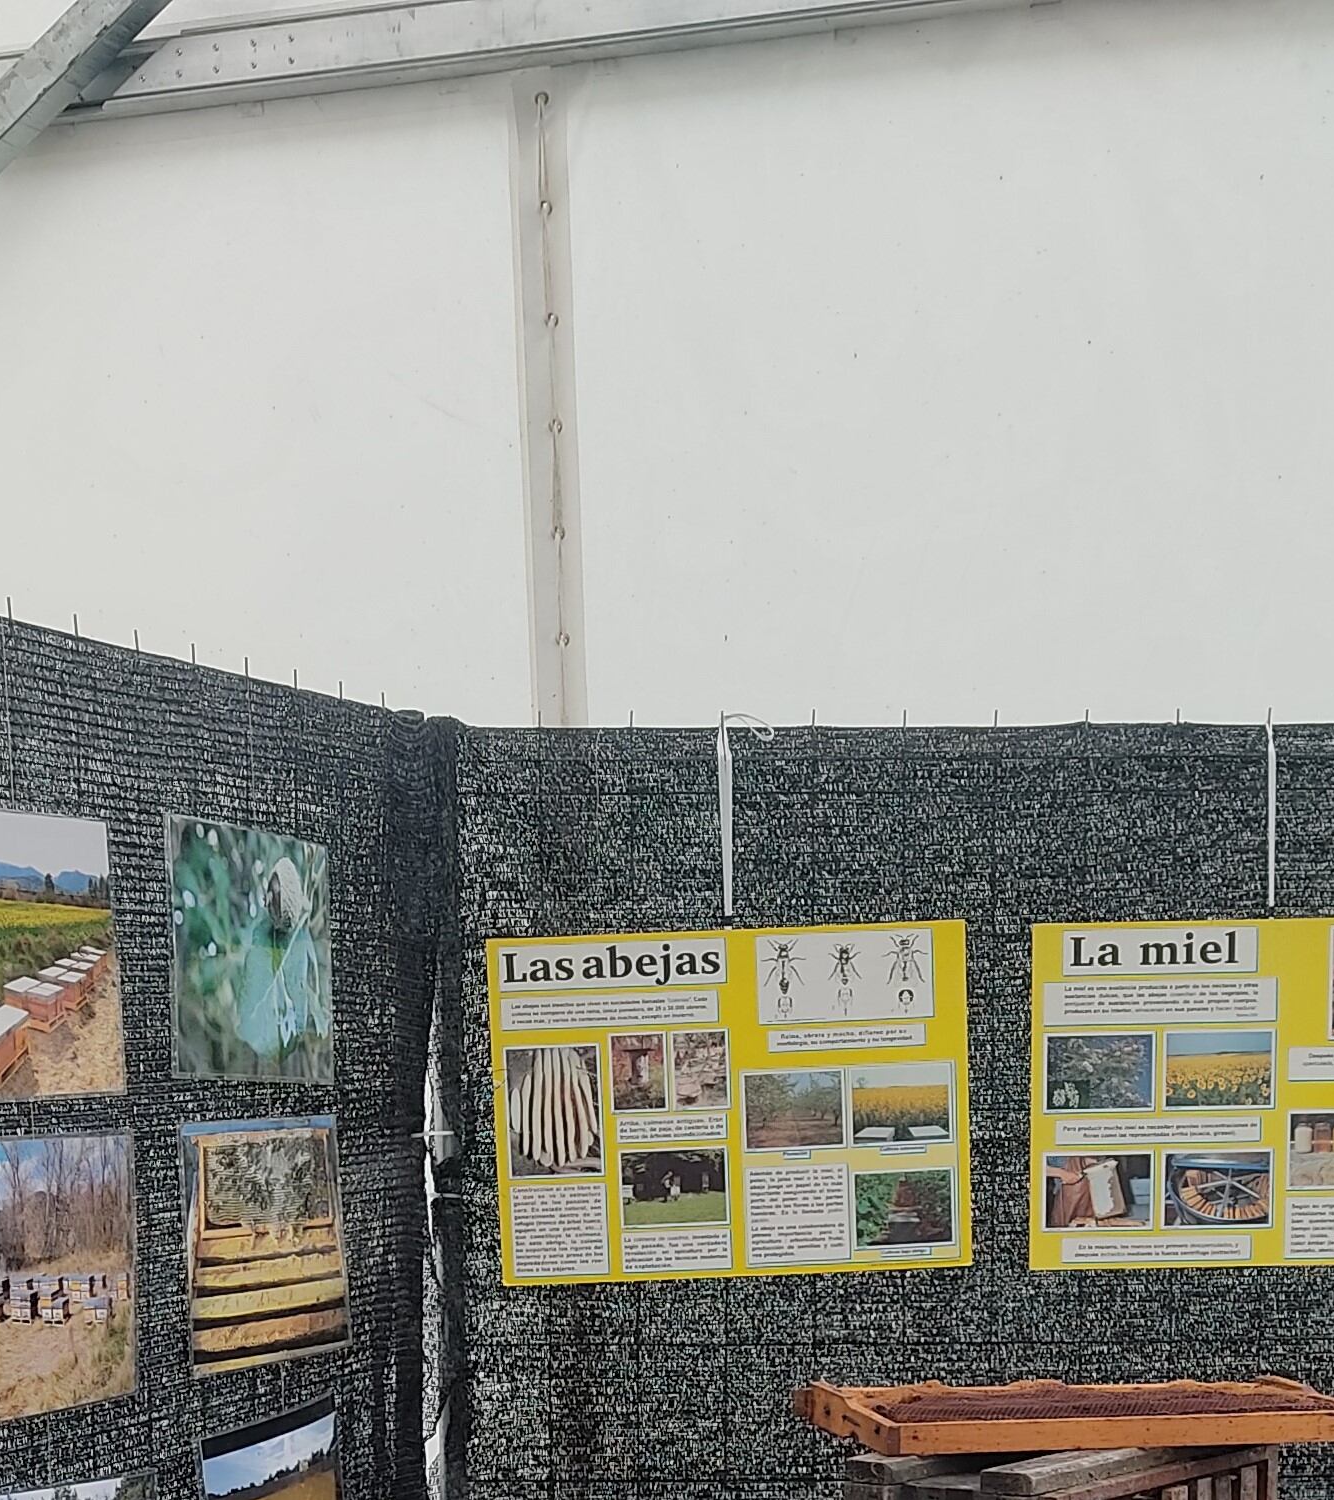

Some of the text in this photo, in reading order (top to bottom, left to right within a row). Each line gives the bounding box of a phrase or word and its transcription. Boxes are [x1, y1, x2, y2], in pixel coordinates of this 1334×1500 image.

[502, 943, 721, 985] Las abejas
[1069, 931, 1238, 967] La miel
